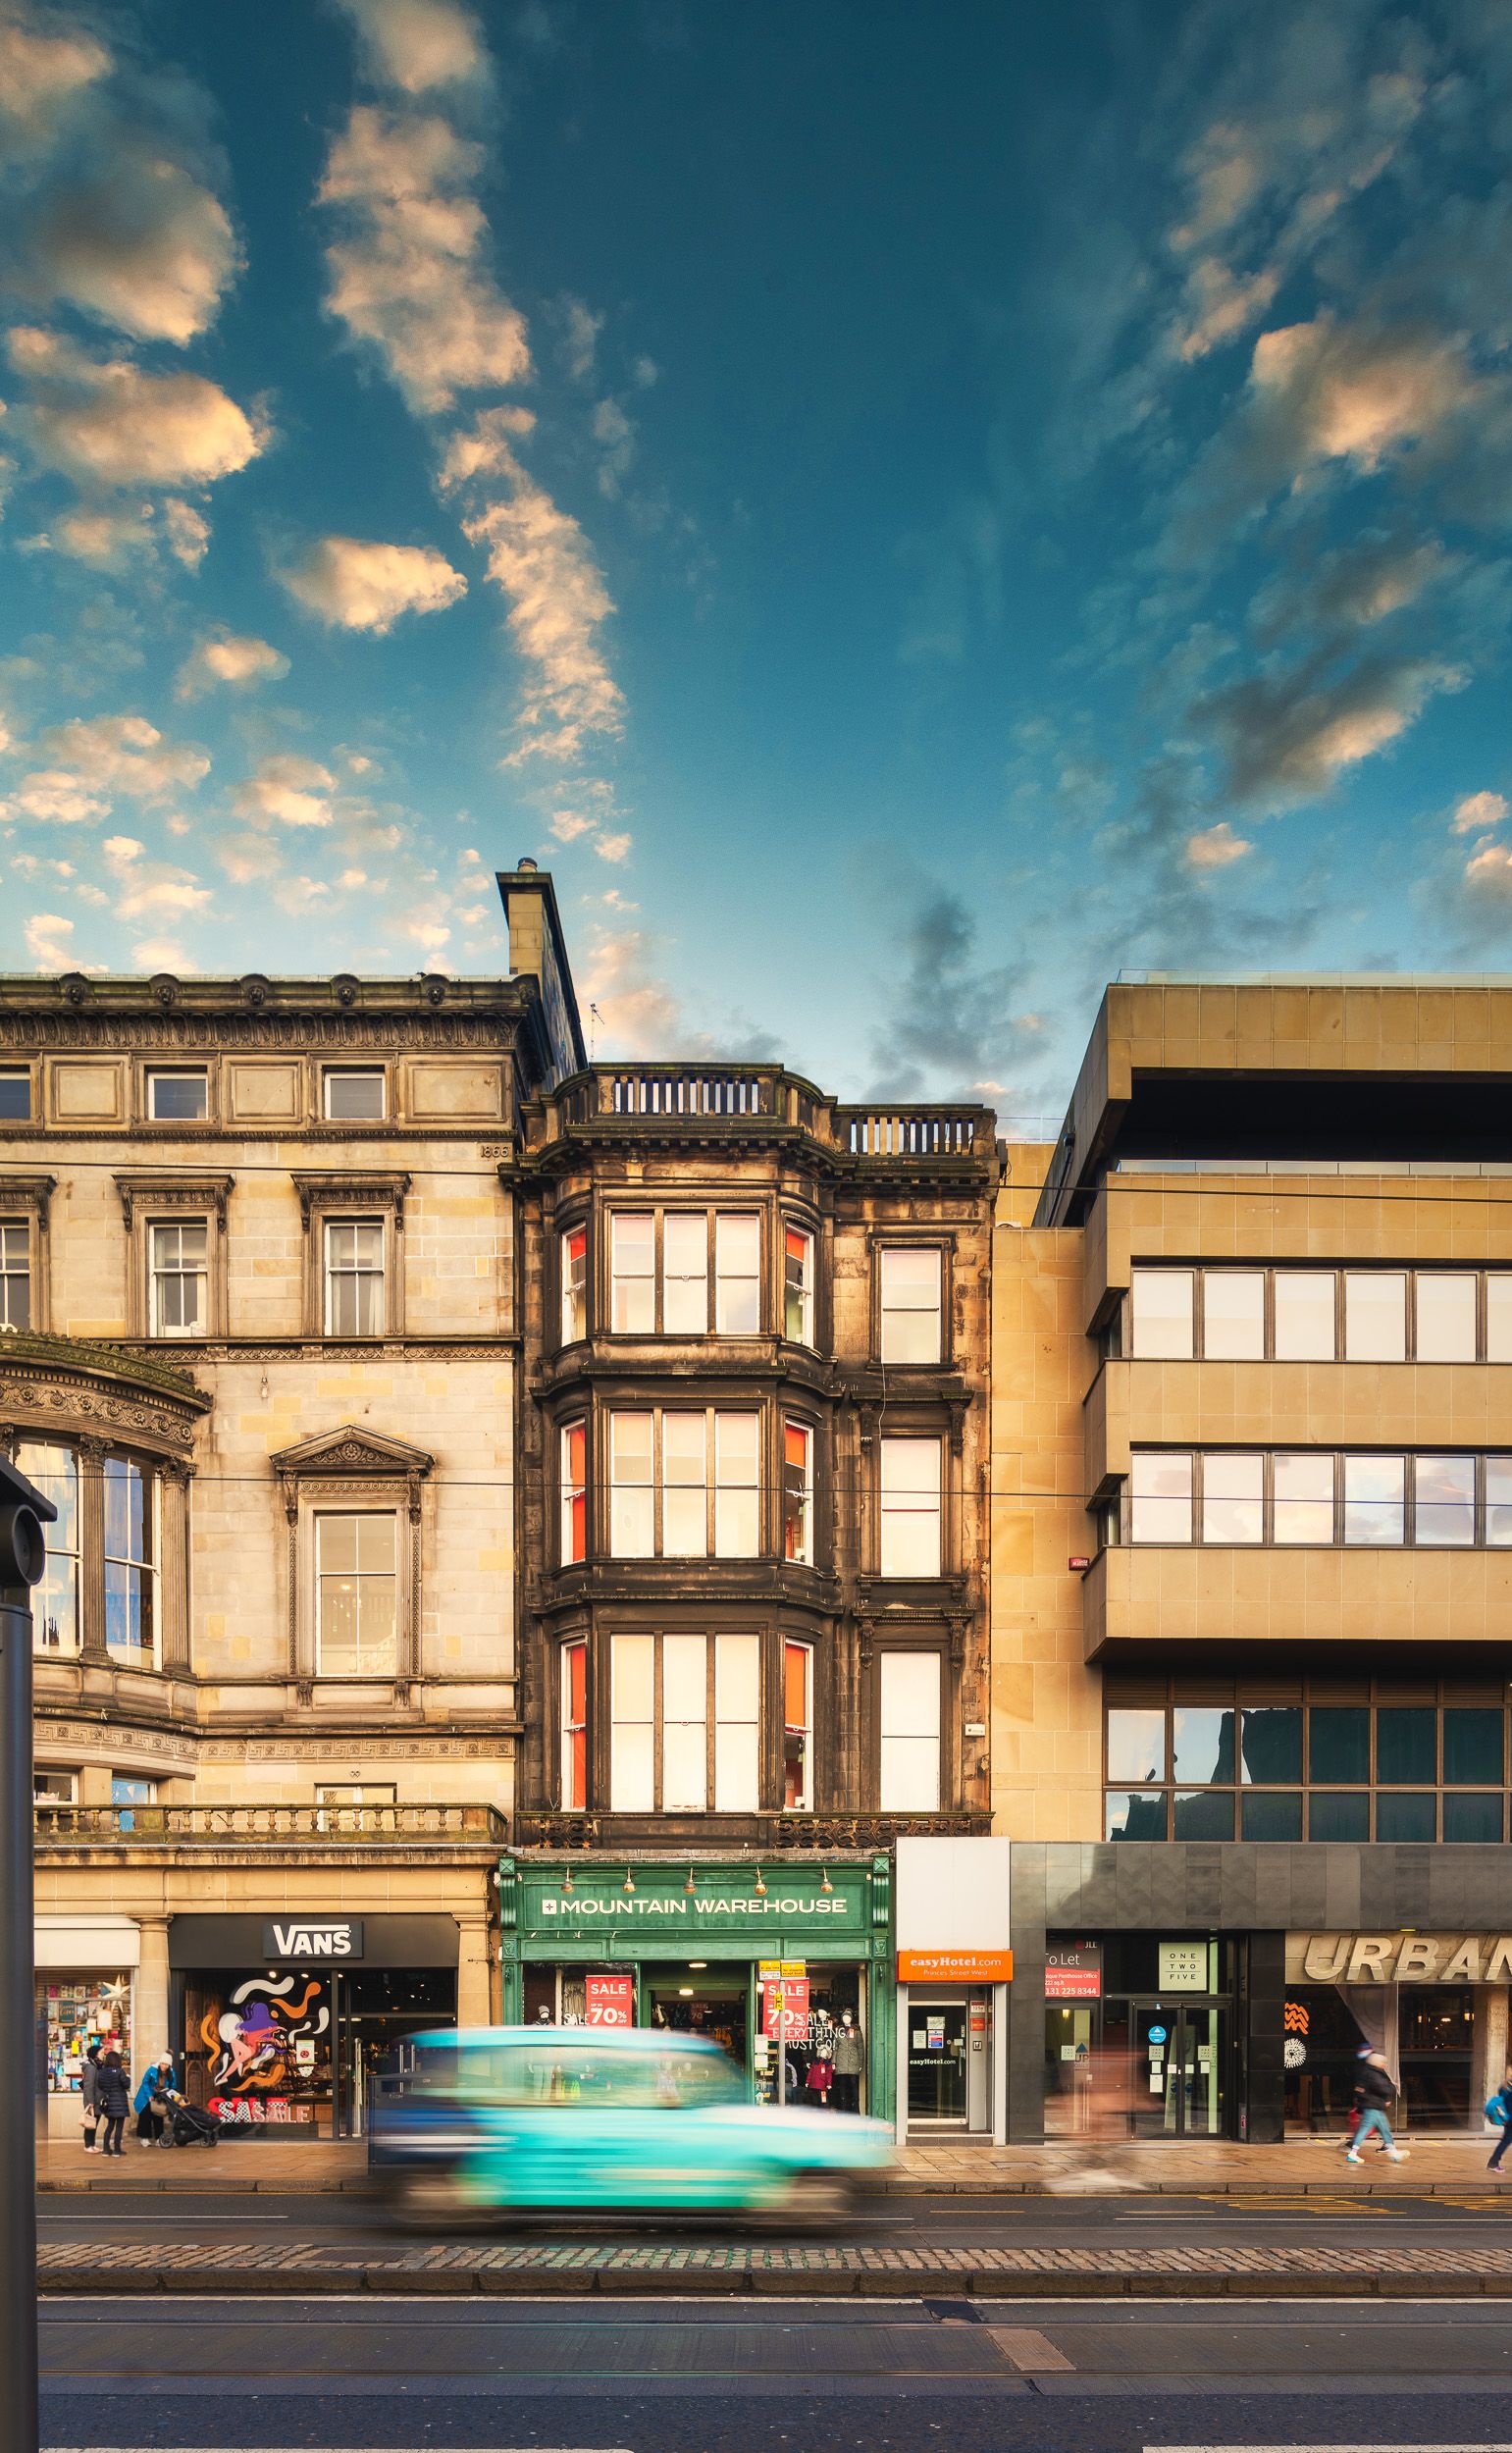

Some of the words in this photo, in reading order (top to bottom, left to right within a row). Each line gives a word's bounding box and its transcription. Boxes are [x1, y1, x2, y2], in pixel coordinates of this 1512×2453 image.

[481, 1145, 509, 1158] 1866
[560, 1899, 686, 1914] MOUNTAIN
[694, 1899, 848, 1914] WAREHOUSE
[273, 1924, 351, 1956] VANS
[910, 1957, 1002, 1968] easyHotel.com
[1061, 1953, 1080, 1965] Let
[591, 1983, 627, 1995] SALE
[563, 2012, 591, 2026] SALE
[591, 2008, 627, 2024] 70%
[772, 2026, 847, 2039] EERYTHING
[217, 2100, 288, 2123] SA
